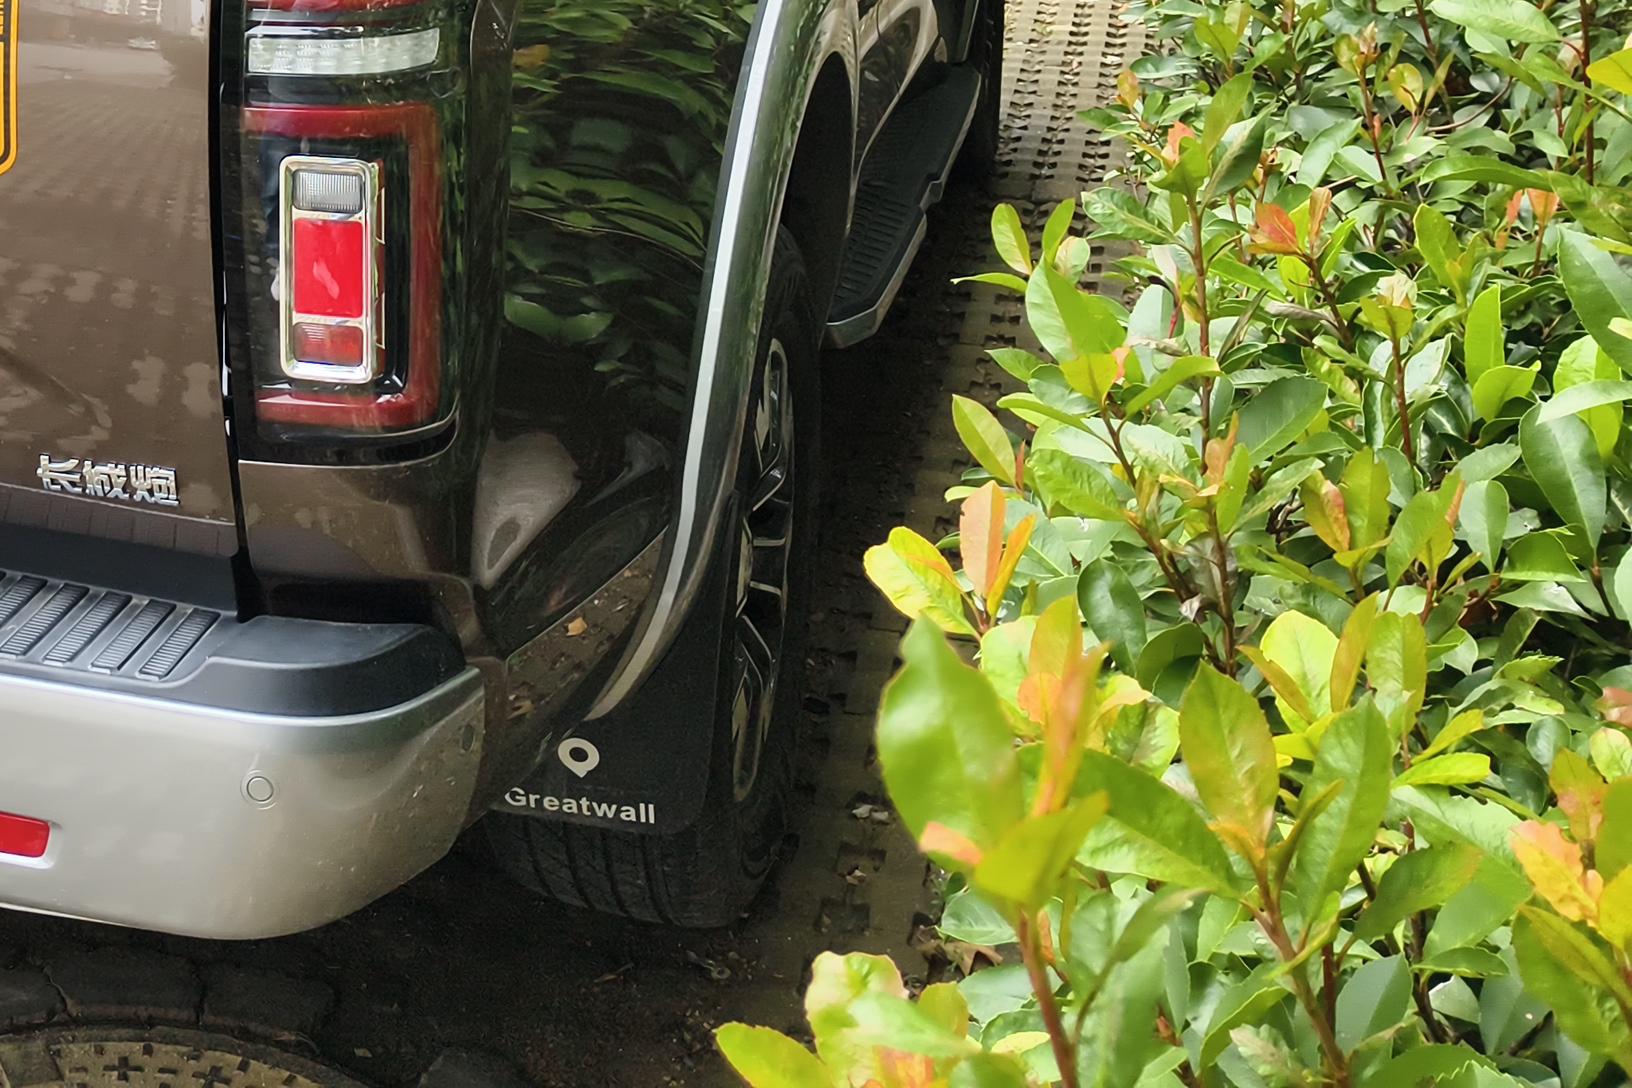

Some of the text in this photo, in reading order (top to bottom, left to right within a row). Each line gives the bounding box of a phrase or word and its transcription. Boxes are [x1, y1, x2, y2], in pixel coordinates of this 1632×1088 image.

[37, 454, 180, 507] 长城炮
[504, 786, 656, 824] Greatwall
